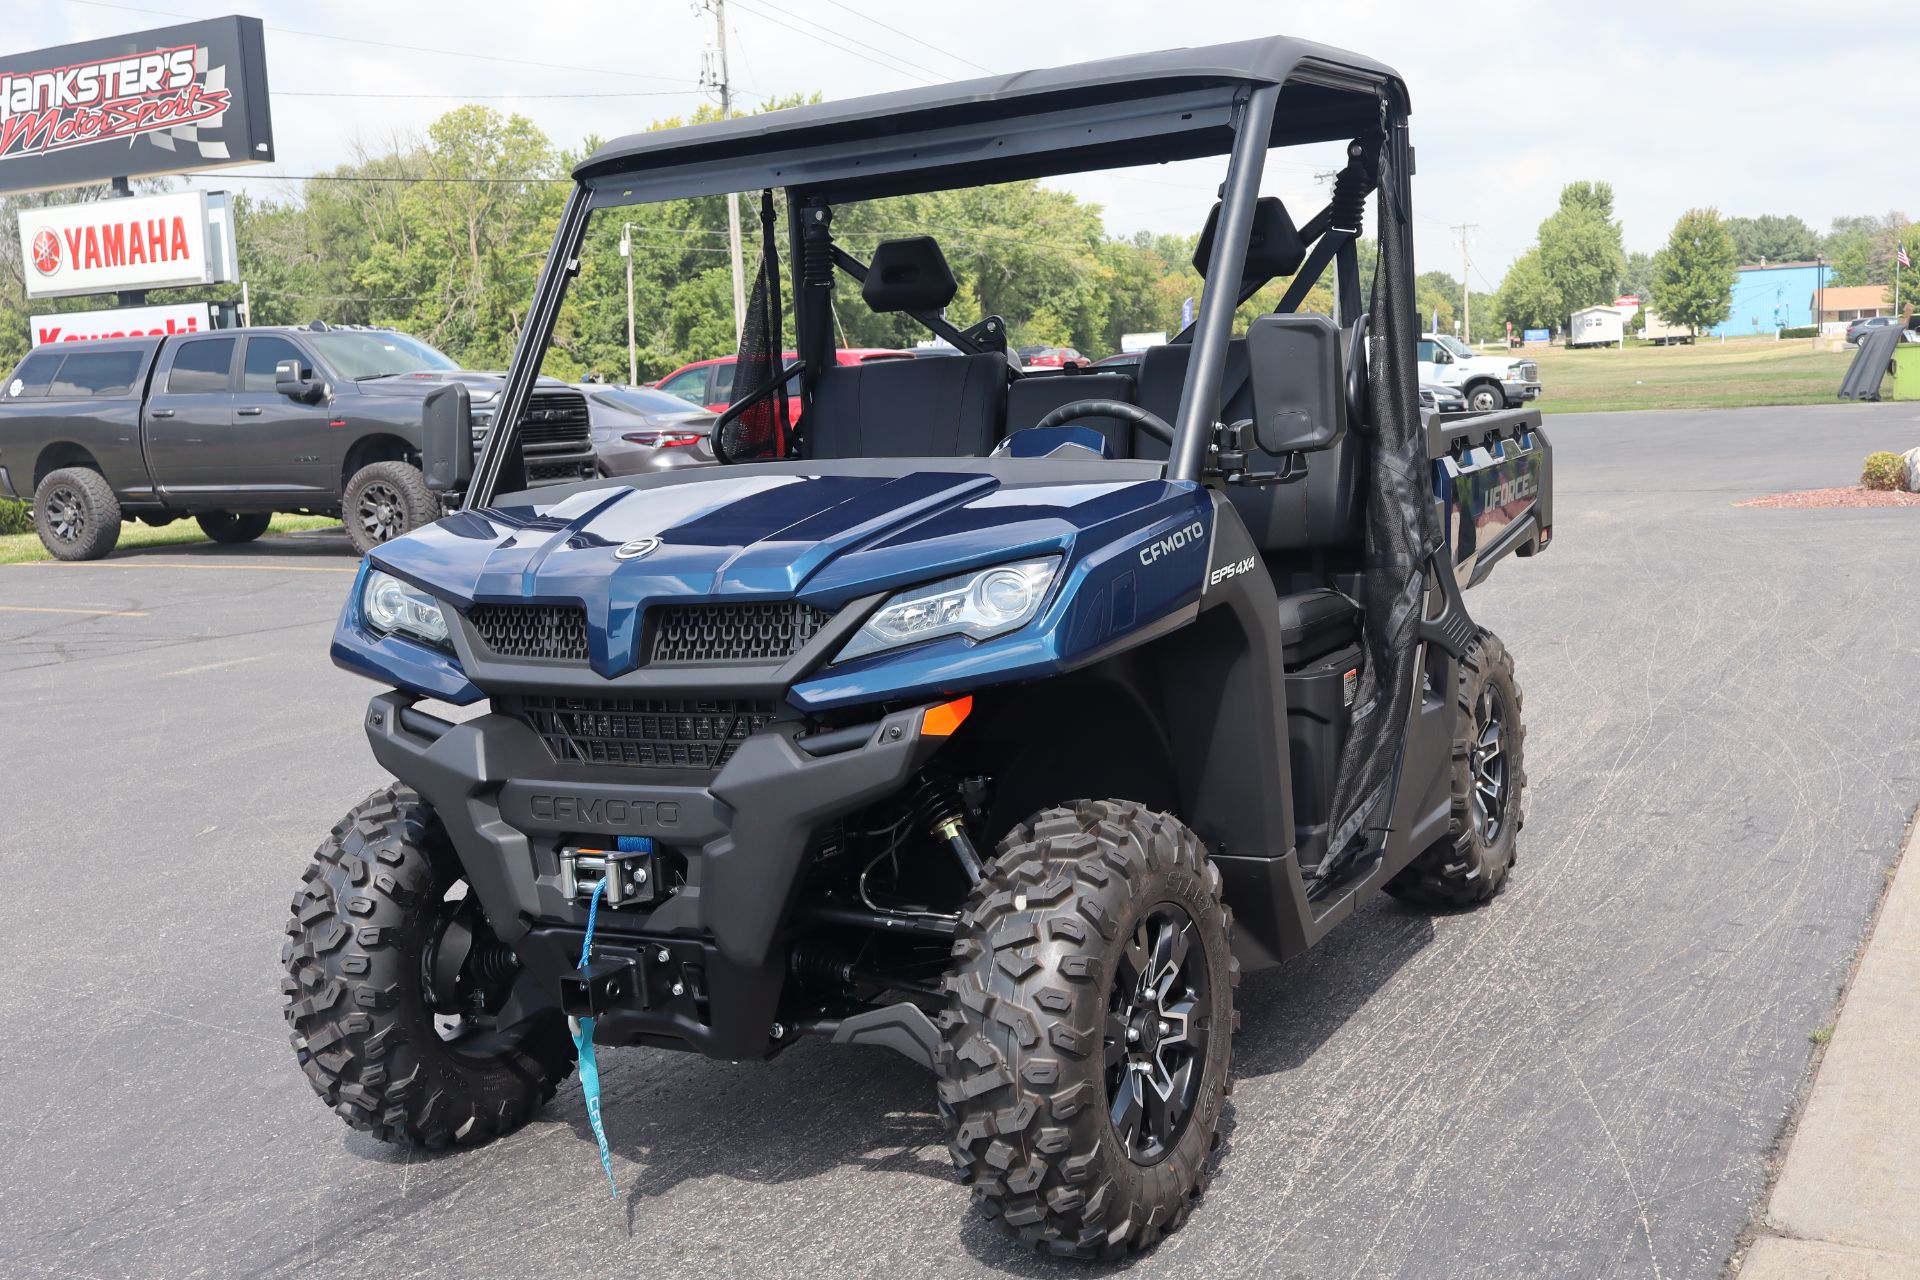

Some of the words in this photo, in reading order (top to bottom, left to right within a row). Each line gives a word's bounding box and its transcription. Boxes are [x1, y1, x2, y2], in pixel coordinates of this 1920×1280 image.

[64, 216, 190, 270] YAMAHA
[1484, 473, 1530, 513] UFORCE
[1140, 522, 1203, 566] CFMOTO
[1211, 563, 1235, 585] EPS
[531, 795, 682, 828] CFMOTO
